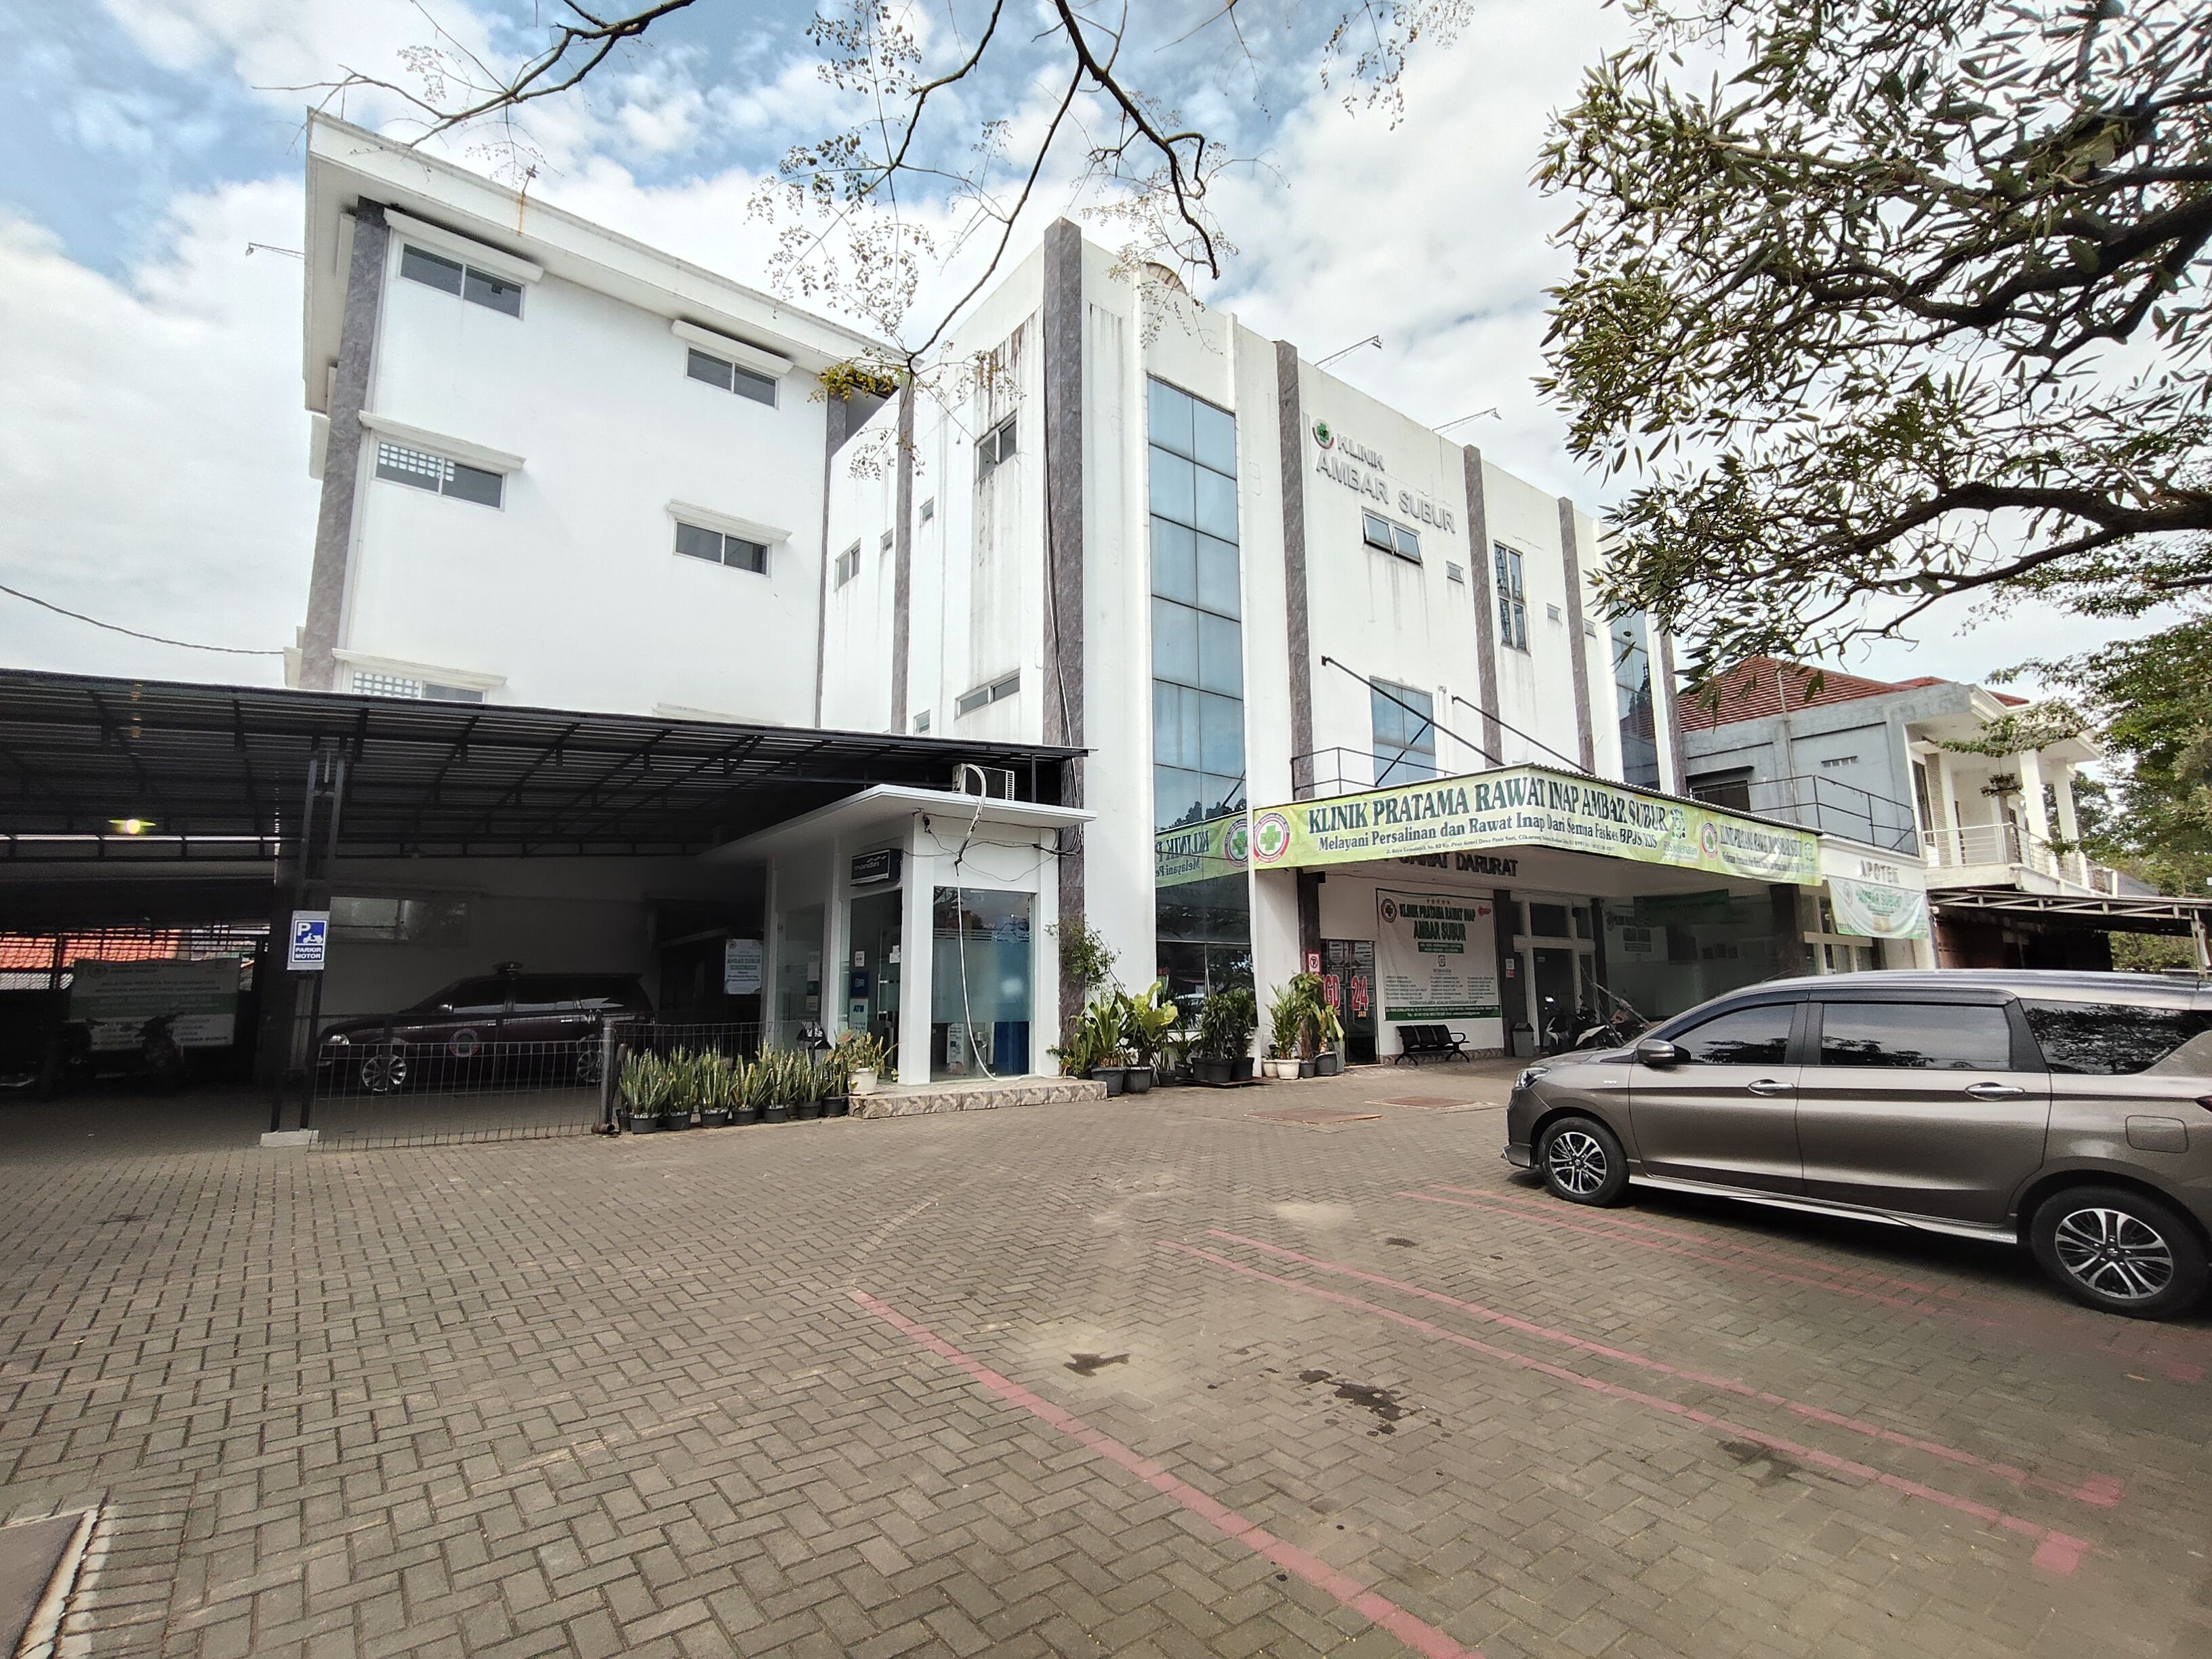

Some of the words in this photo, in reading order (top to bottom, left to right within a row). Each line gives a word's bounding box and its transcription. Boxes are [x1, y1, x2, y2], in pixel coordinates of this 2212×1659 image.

[1337, 434, 1385, 472] KLINIK
[1316, 450, 1389, 504] AMBAR
[1398, 489, 1456, 533] SUBUR
[1309, 802, 1368, 834] KLINIK
[1372, 787, 1469, 826] PRATAMA
[1475, 777, 1545, 812] RAWAT
[1549, 781, 1579, 813] INAP
[1582, 789, 1628, 823] AMBAR
[1629, 800, 1668, 832] SUBUR
[1319, 832, 1369, 851] Melayani
[1372, 826, 1436, 845] Persalinan
[1440, 821, 1465, 837] dan
[1469, 815, 1512, 834] Rawat
[1516, 812, 1544, 832] Inap
[1547, 814, 1565, 832] Dari
[1595, 823, 1619, 842] Faskes
[1456, 853, 1518, 877] DARURAT
[1414, 920, 1441, 940] AMBAR
[1441, 922, 1467, 941] SUBUR
[853, 1004, 865, 1013] ATM
[1351, 976, 1369, 1010] 24
